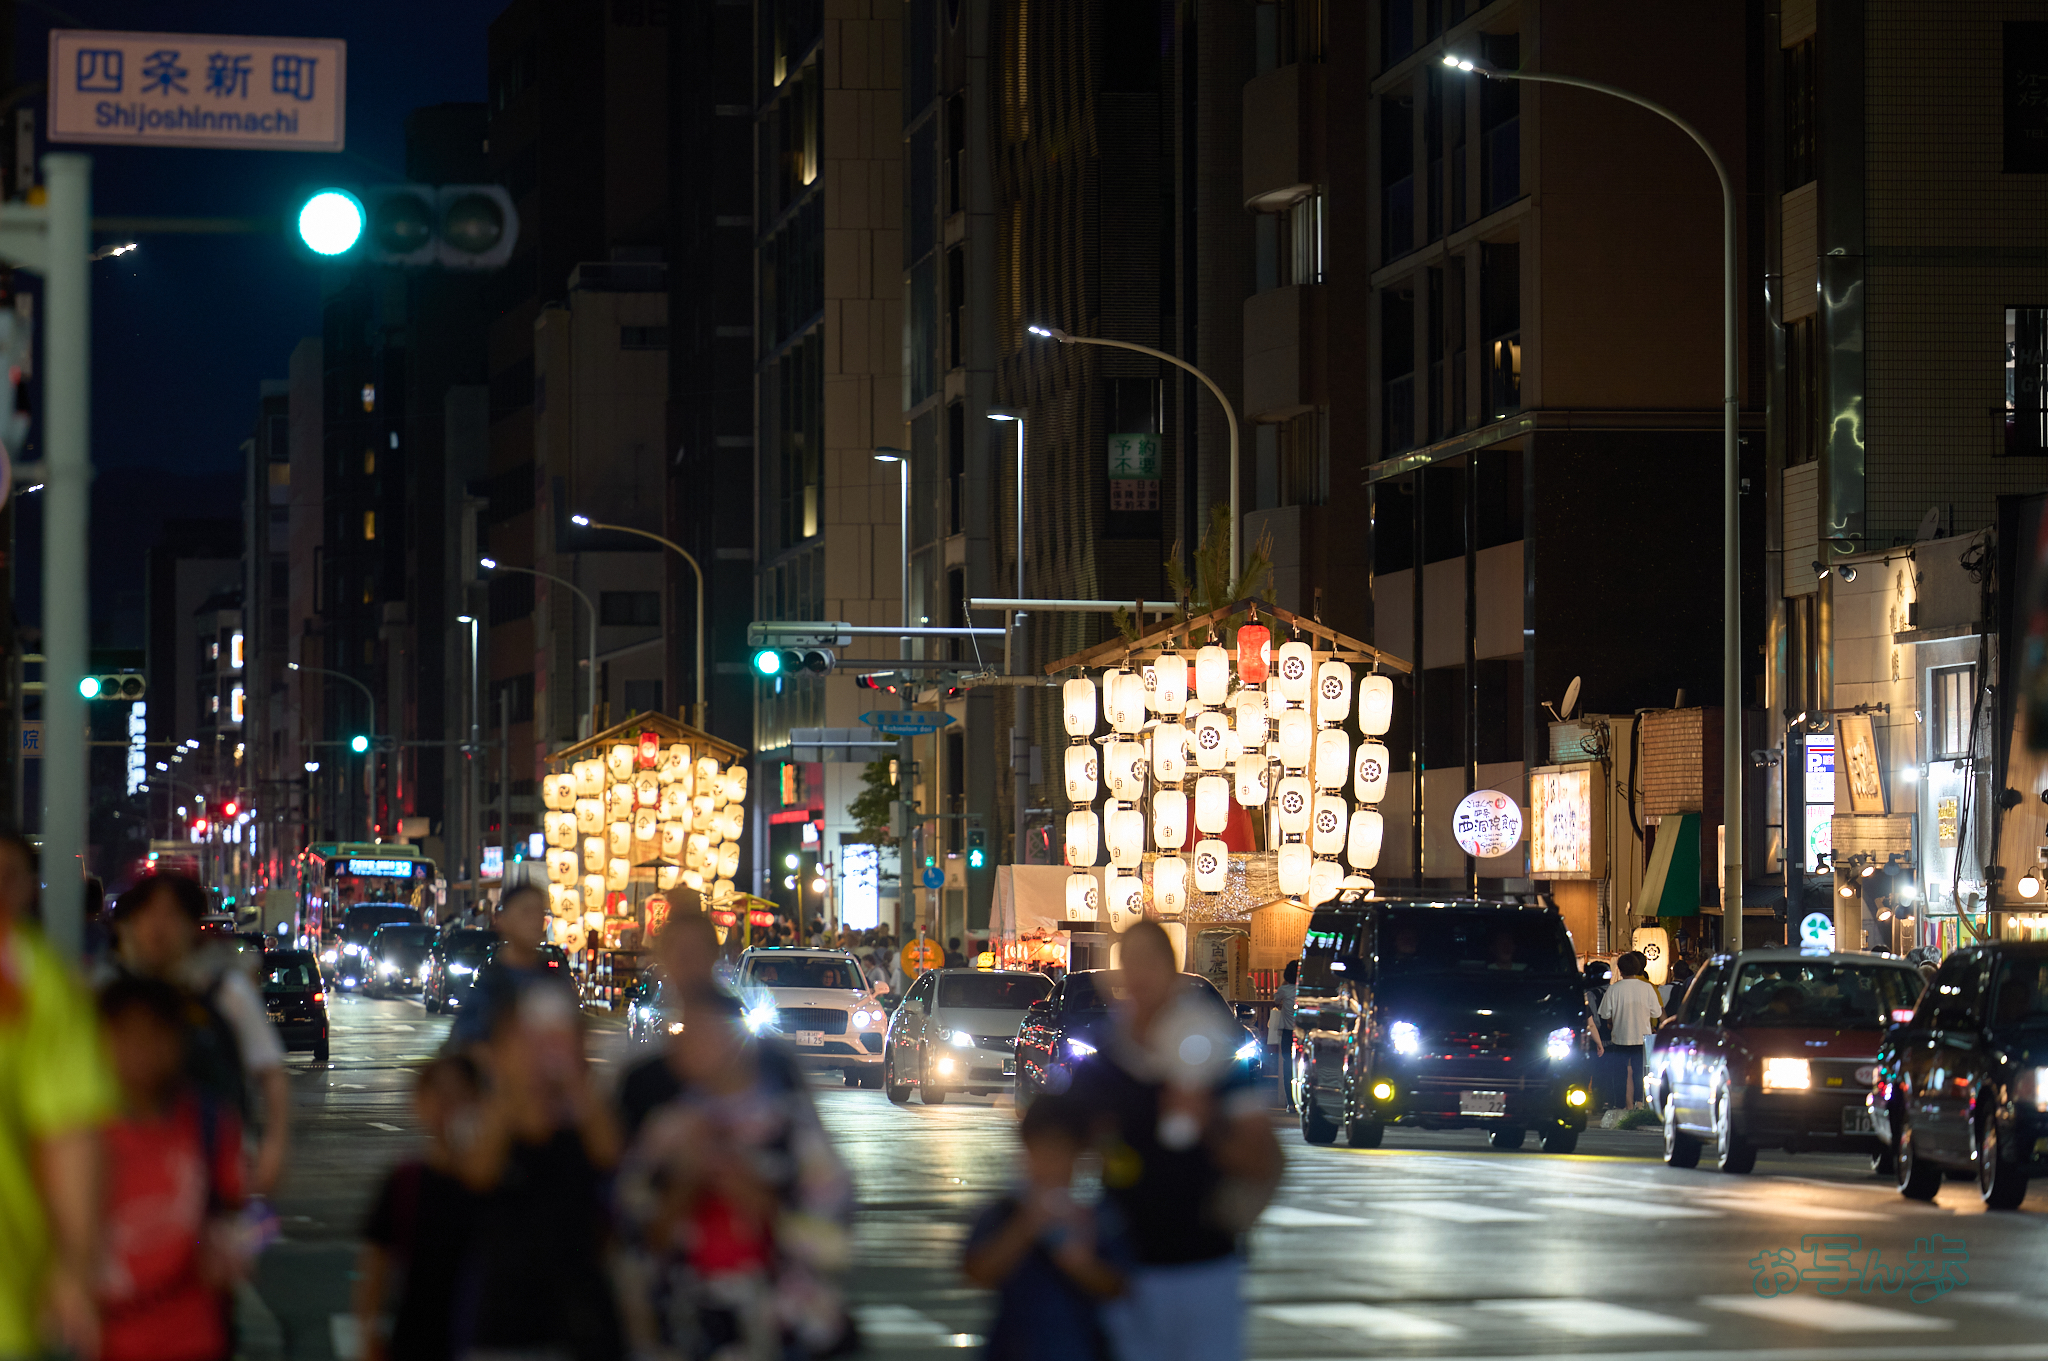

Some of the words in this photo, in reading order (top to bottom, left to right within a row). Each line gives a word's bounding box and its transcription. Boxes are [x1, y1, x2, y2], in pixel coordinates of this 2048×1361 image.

[76, 48, 318, 101] 四条新町
[95, 101, 299, 133] Shijoshinmachi
[1114, 439, 1157, 457] 予約
[1114, 457, 1156, 475] 不要
[395, 861, 411, 876] 32
